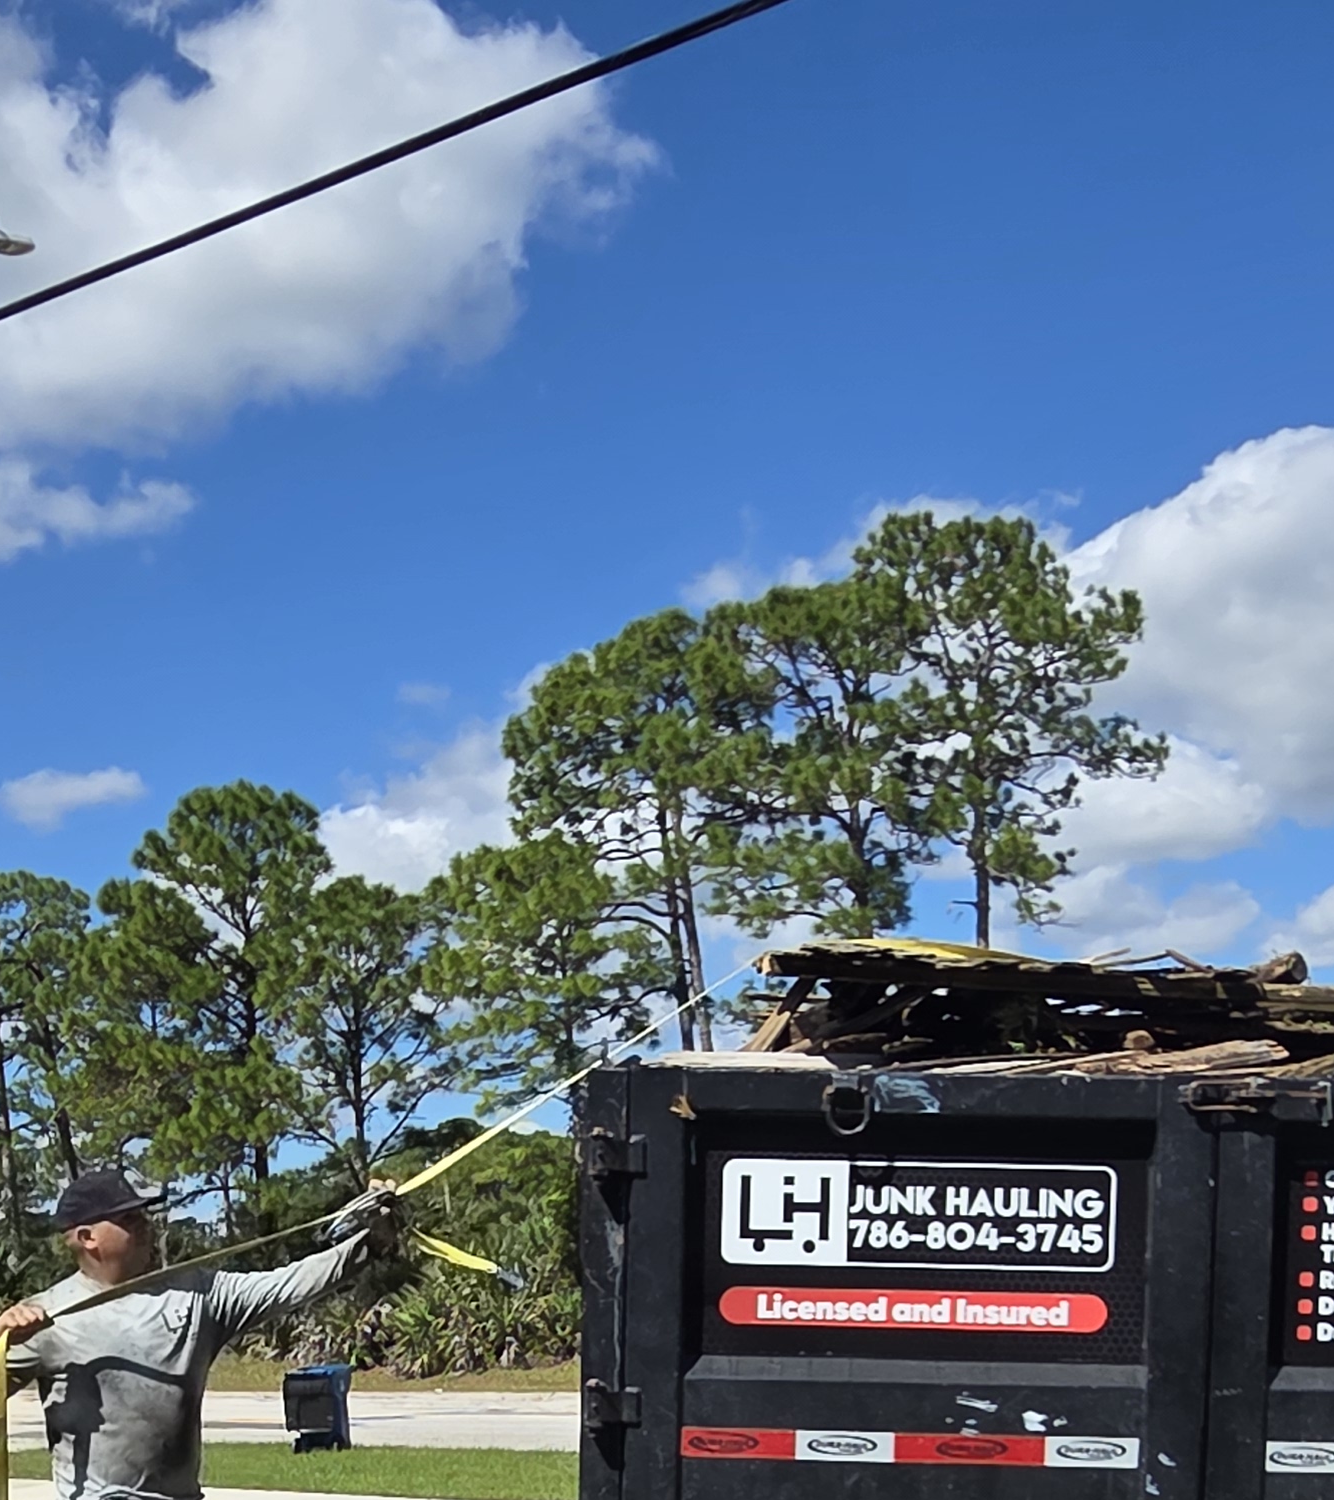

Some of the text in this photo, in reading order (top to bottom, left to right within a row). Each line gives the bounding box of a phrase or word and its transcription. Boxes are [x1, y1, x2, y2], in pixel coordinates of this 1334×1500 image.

[849, 1185, 1105, 1219] JUNK HAULING
[848, 1219, 1104, 1253] 786-804-3745
[757, 1293, 1070, 1327] Licensed and Insured
